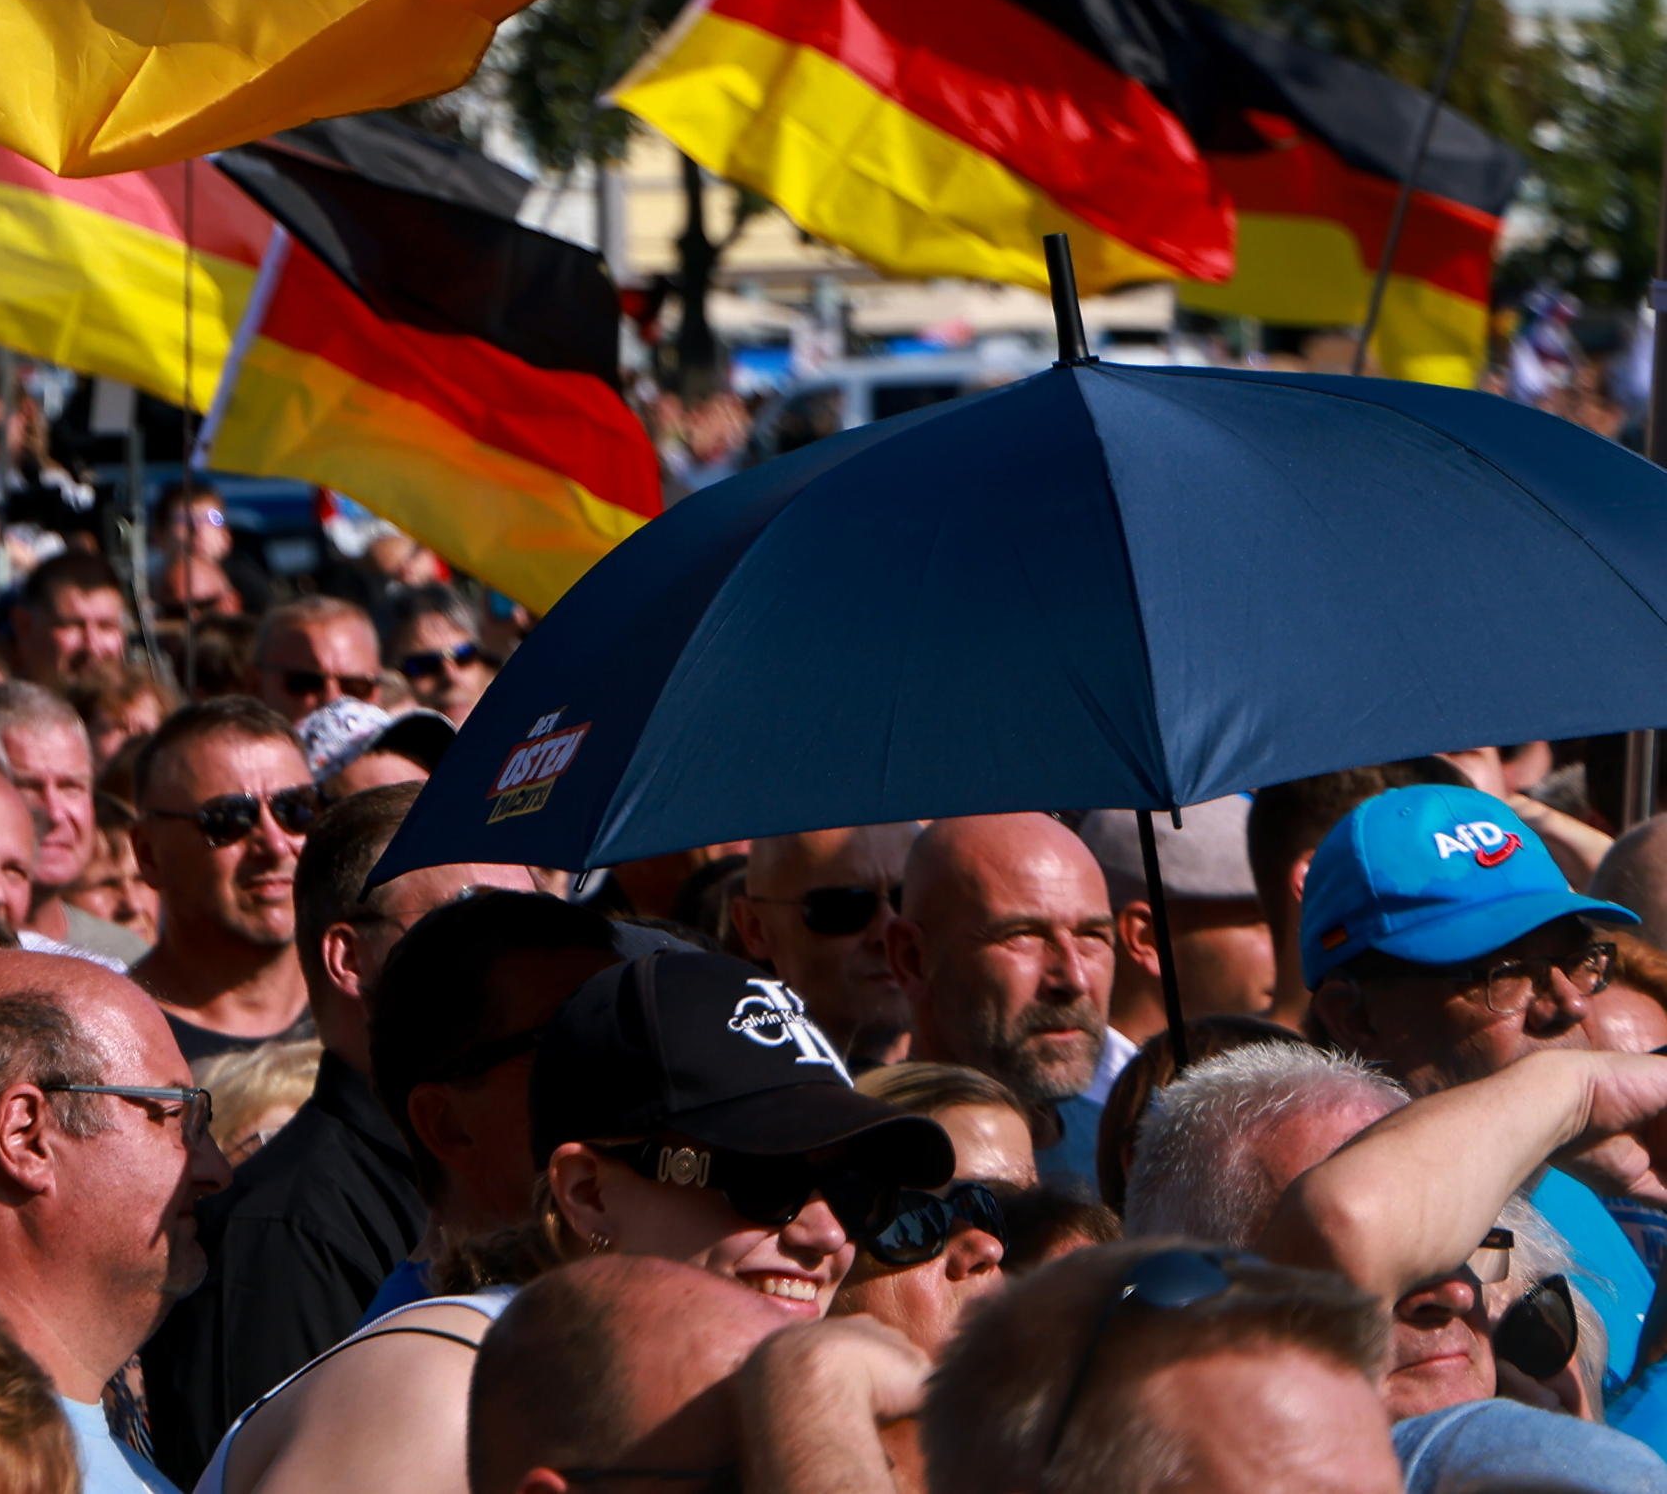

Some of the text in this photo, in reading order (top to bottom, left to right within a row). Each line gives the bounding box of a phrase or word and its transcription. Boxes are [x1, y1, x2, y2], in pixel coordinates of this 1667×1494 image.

[496, 728, 585, 791] OSTEN
[1433, 820, 1504, 859] AfD
[727, 1010, 782, 1031] Calvin
